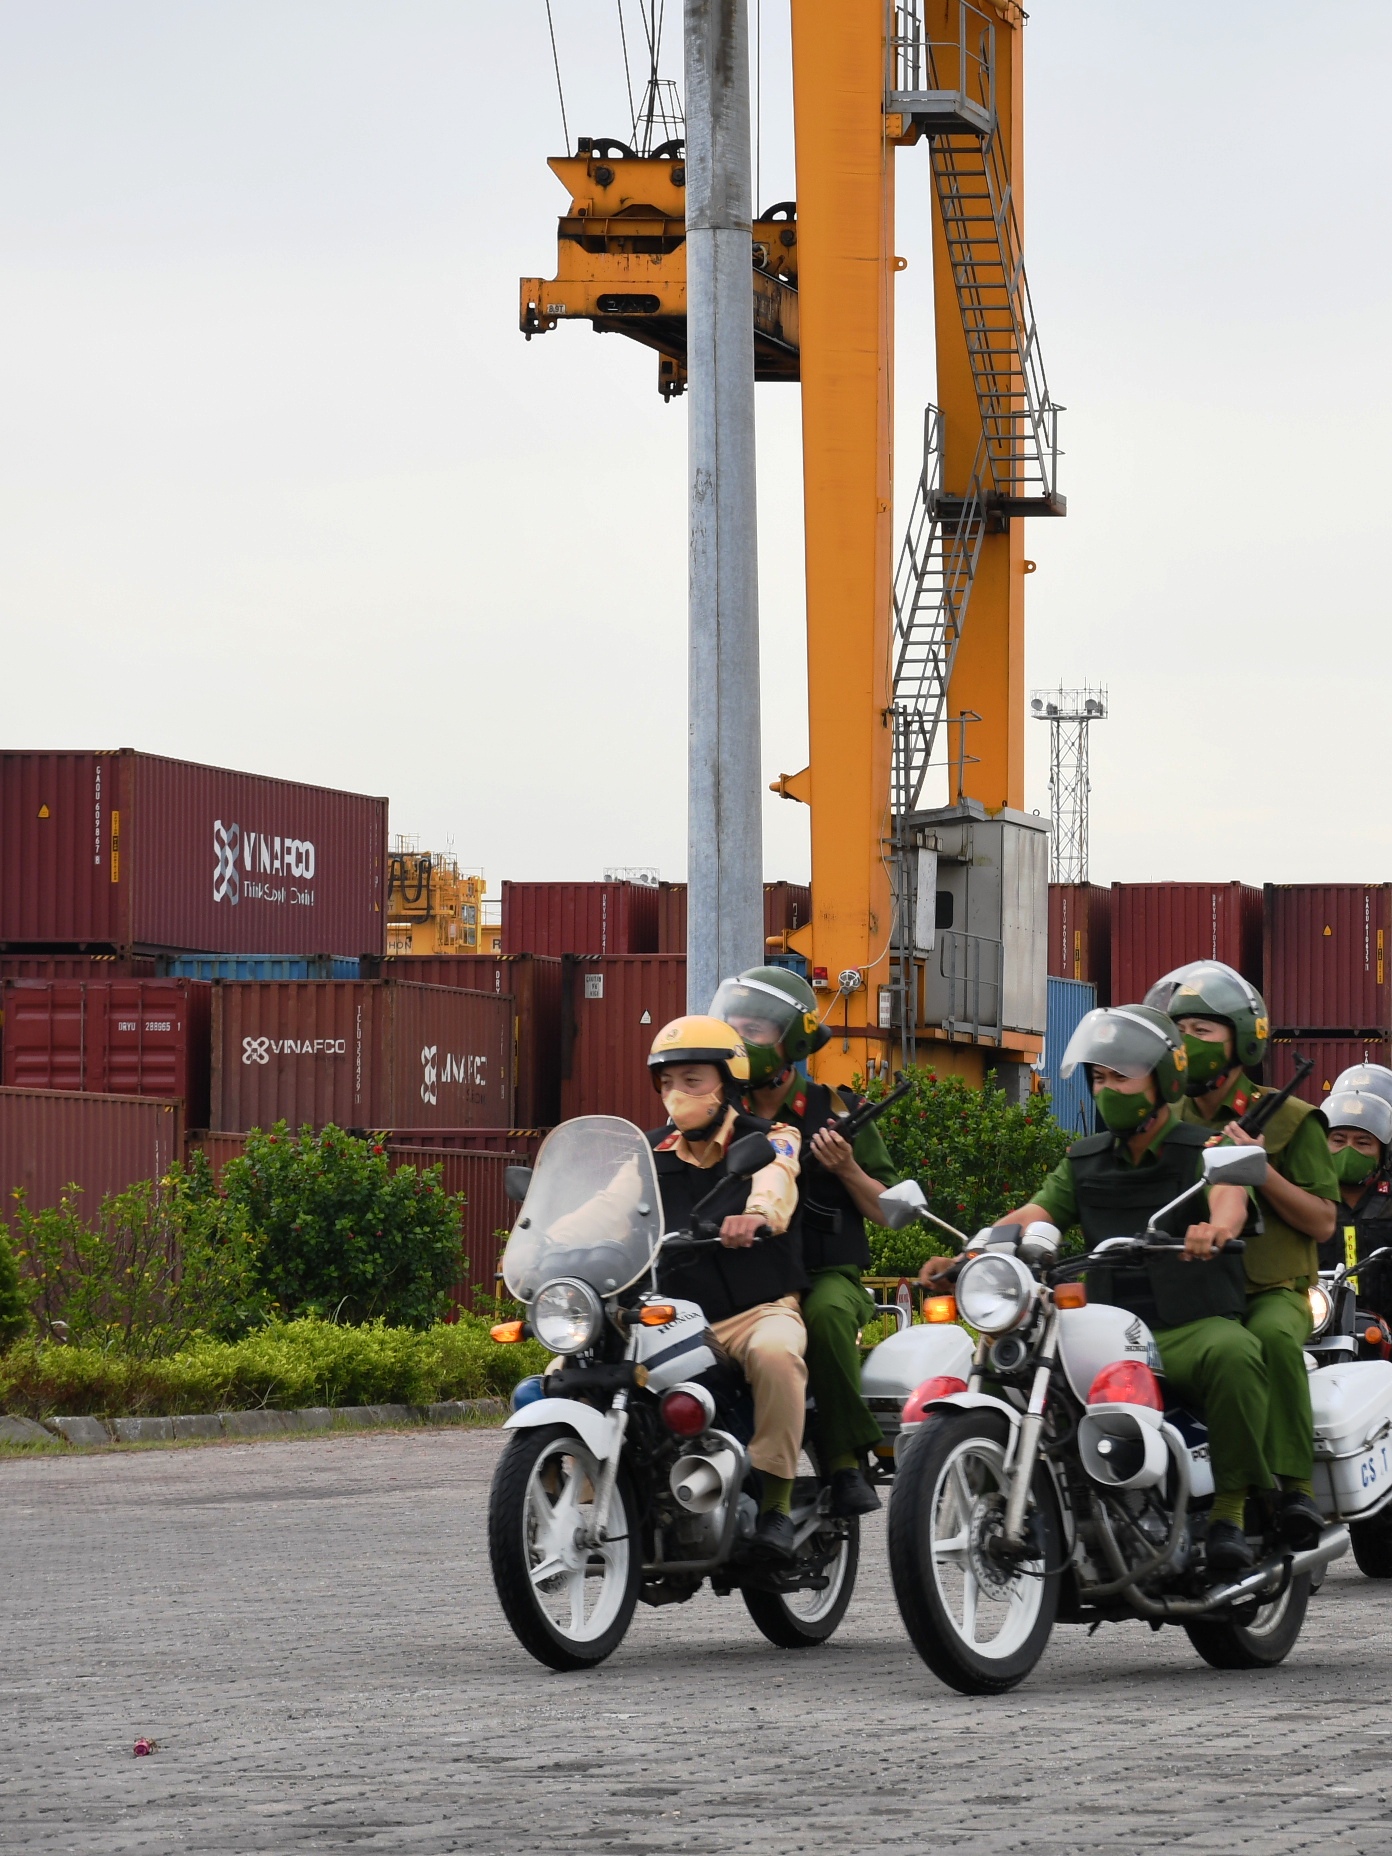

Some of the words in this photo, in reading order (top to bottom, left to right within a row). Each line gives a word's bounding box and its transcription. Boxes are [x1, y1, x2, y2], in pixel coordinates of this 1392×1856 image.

[244, 831, 315, 879] VINAFCO
[270, 1039, 346, 1054] VINAFCO
[656, 1312, 702, 1334] HONDA
